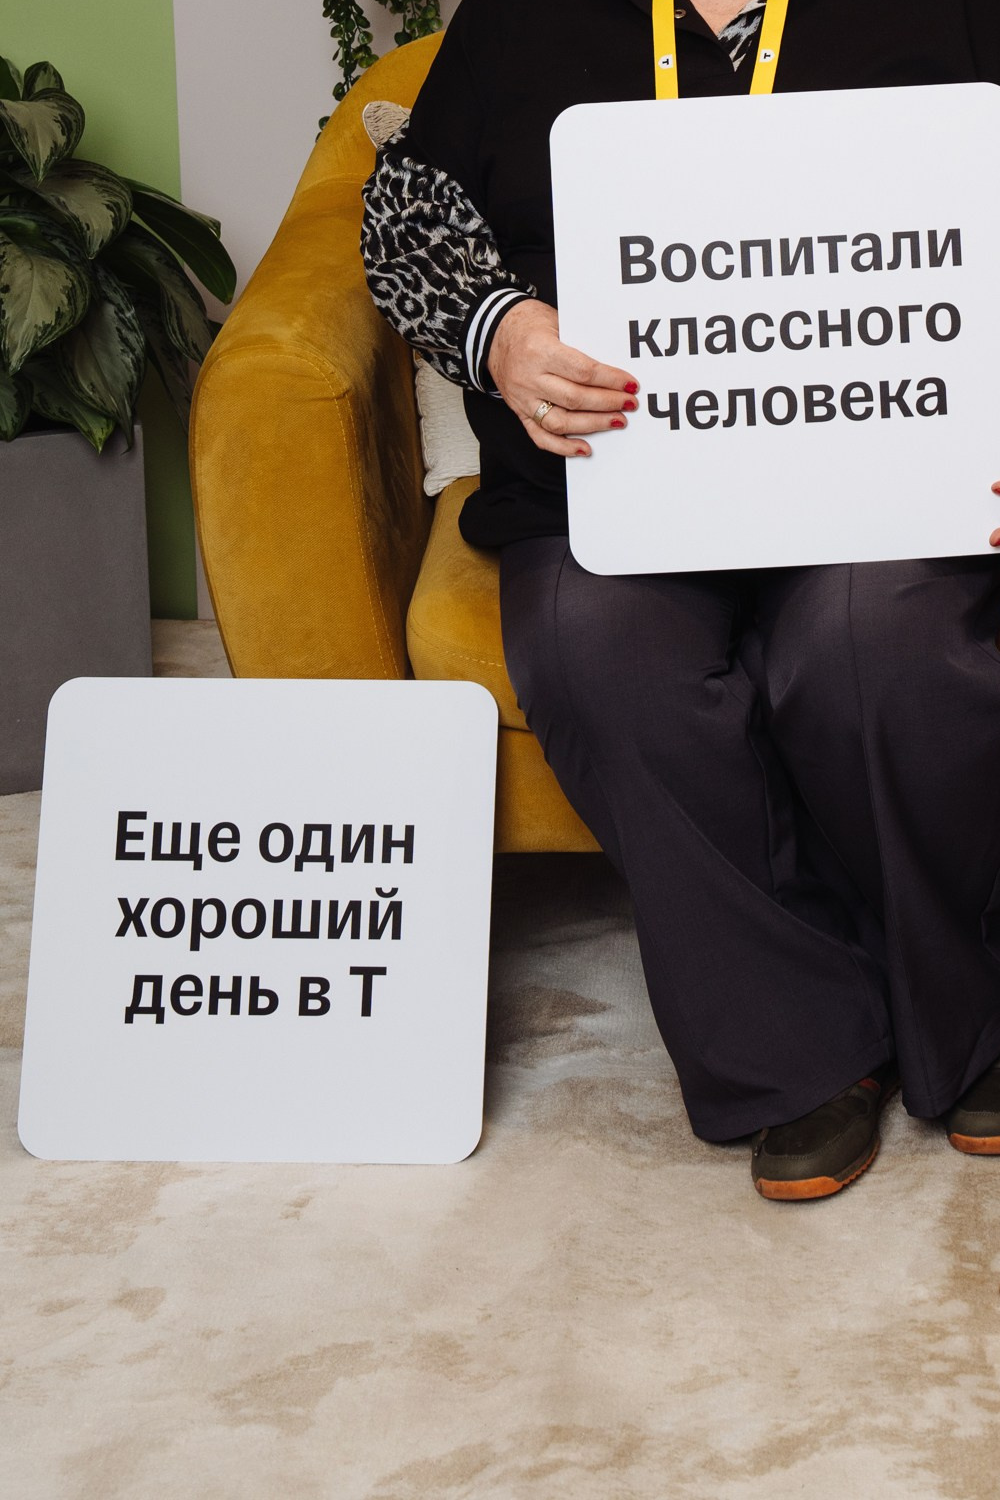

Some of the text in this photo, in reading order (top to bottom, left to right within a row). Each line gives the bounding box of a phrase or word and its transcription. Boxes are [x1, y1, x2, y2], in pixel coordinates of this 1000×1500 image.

[619, 228, 963, 285] Воспитали
[628, 302, 962, 359] классного
[647, 376, 948, 431] человека
[115, 810, 415, 873] Еще один
[115, 887, 403, 952] хороший
[124, 966, 387, 1025] день в Т
